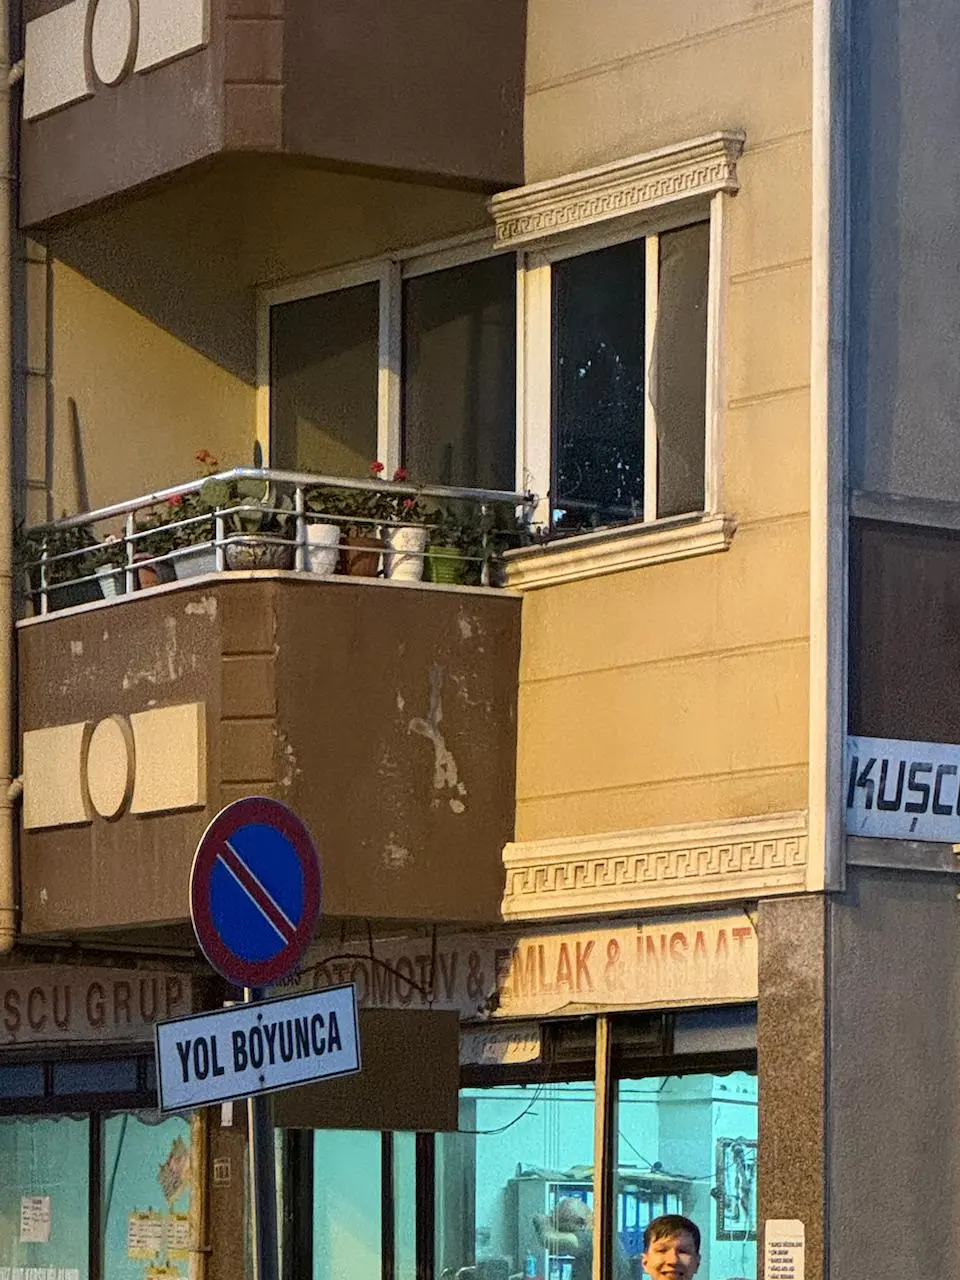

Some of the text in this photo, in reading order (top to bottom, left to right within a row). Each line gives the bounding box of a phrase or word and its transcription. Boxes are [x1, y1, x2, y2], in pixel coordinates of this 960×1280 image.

[466, 950, 486, 998] &
[86, 975, 184, 1030] GRUP
[175, 1034, 225, 1084] YOL
